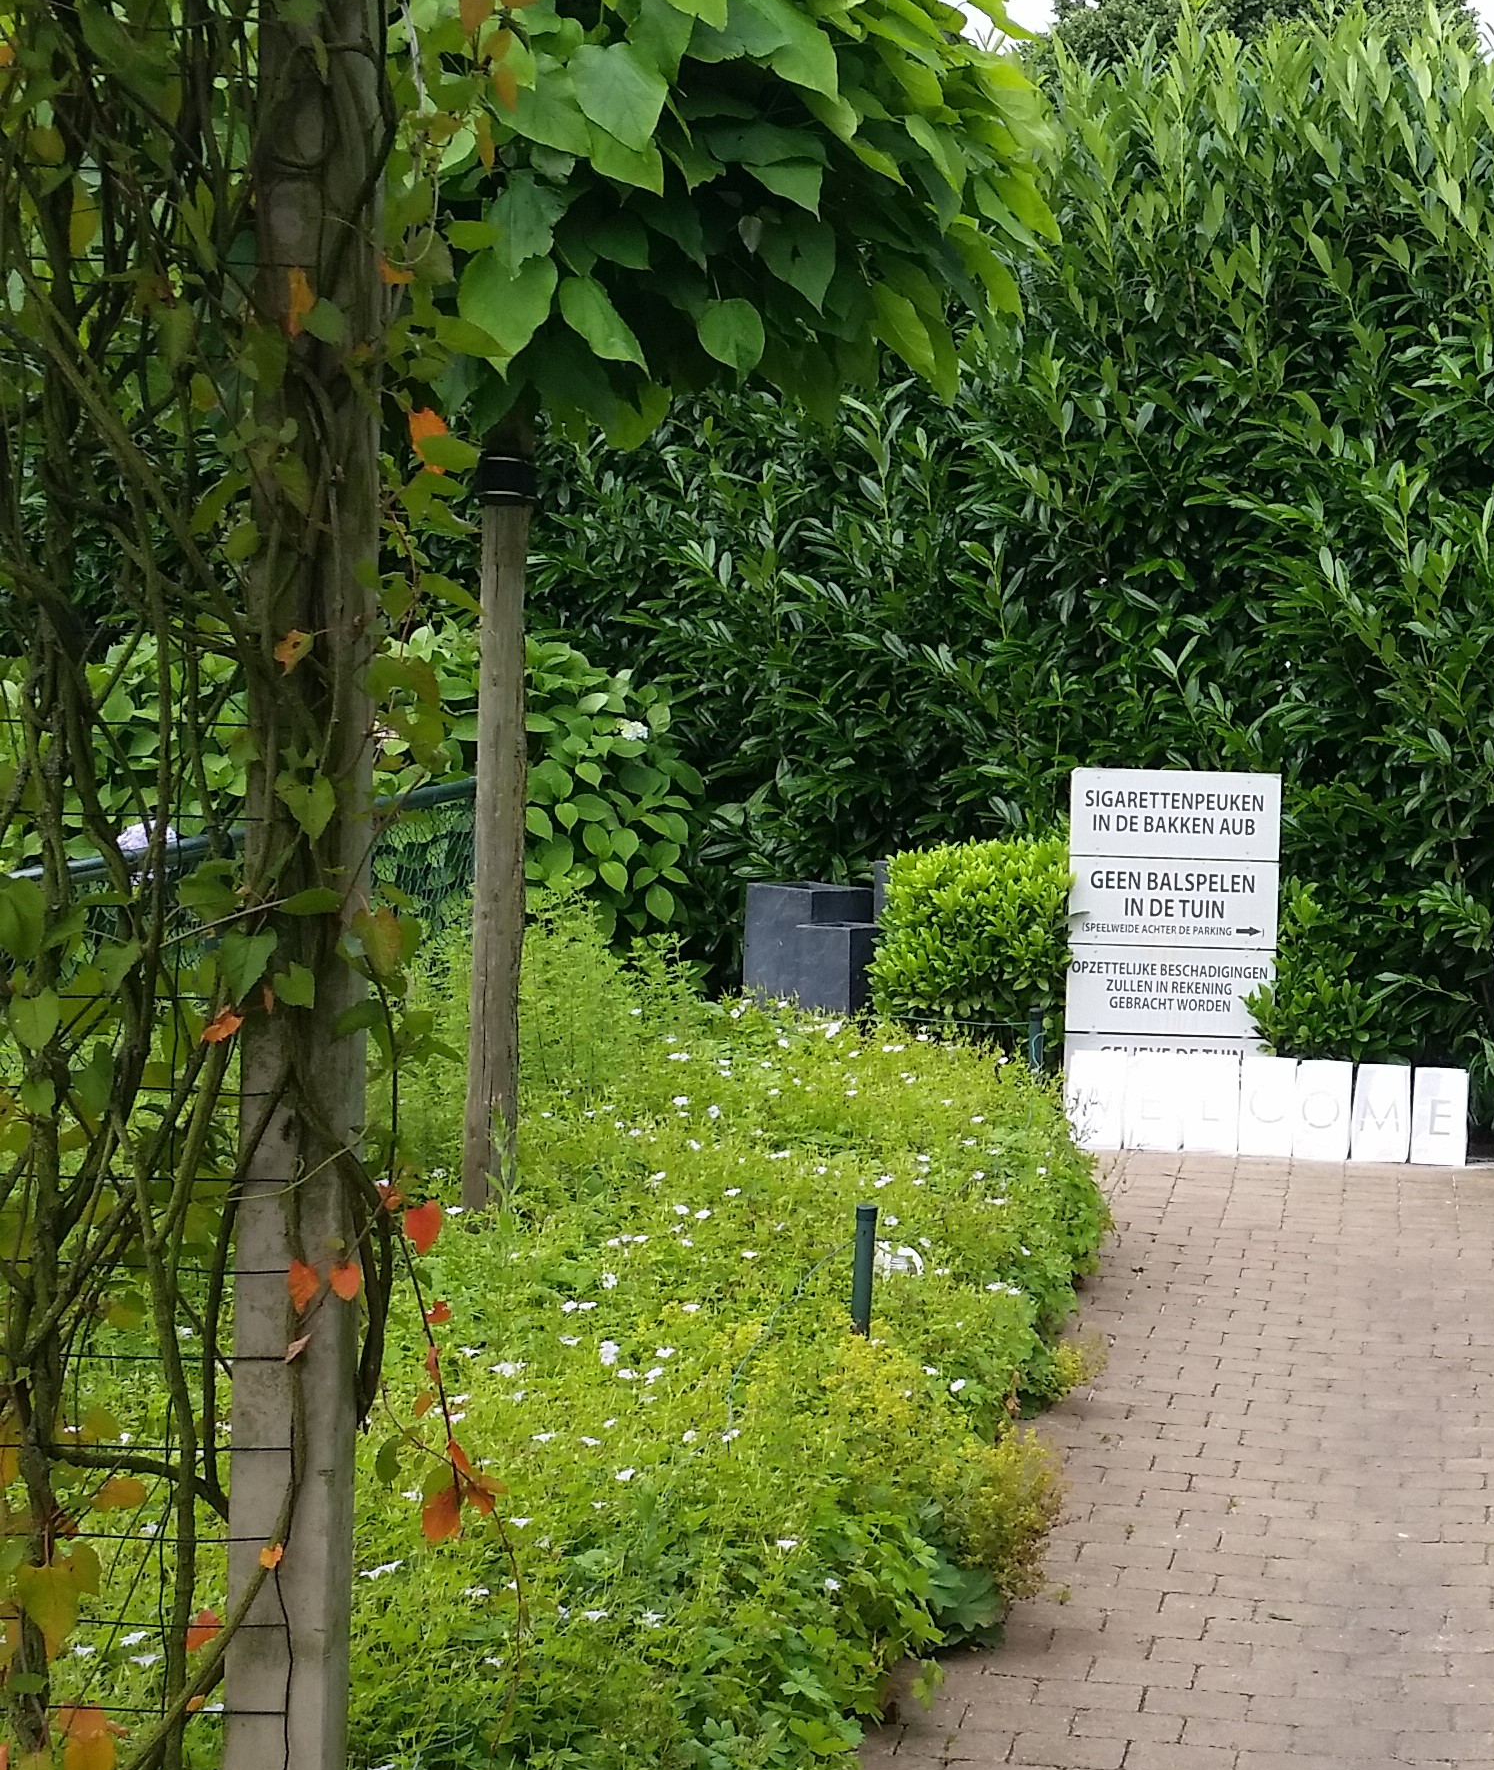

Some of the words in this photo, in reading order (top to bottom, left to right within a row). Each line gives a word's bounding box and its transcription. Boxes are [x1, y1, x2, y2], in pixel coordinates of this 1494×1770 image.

[1085, 790, 1264, 812] SIGARETTENPEUKEN
[1093, 814, 1110, 831] IN
[1116, 815, 1138, 832] DE
[1144, 816, 1214, 834] BAKKEN
[1219, 818, 1255, 835] AUB
[1090, 870, 1141, 890] GEEN
[1147, 872, 1255, 893] BALSPELEN
[1124, 898, 1143, 916] IN
[1150, 899, 1174, 917] DE
[1179, 900, 1225, 919] TUIN
[1082, 922, 1139, 934] (SPEELWEIDE
[1142, 924, 1177, 935] ACHTER
[1179, 925, 1190, 935] DE
[1193, 926, 1232, 936] PARKING
[1072, 960, 1157, 976] OPZETTELIJKE
[1160, 963, 1268, 979] BESCHADIGINGEN
[1106, 979, 1153, 993] ZULLEN
[1156, 981, 1168, 994] IN
[1172, 982, 1232, 995] REKENING
[1109, 996, 1174, 1010] GEBRACHT
[1177, 999, 1231, 1012] WORDEN
